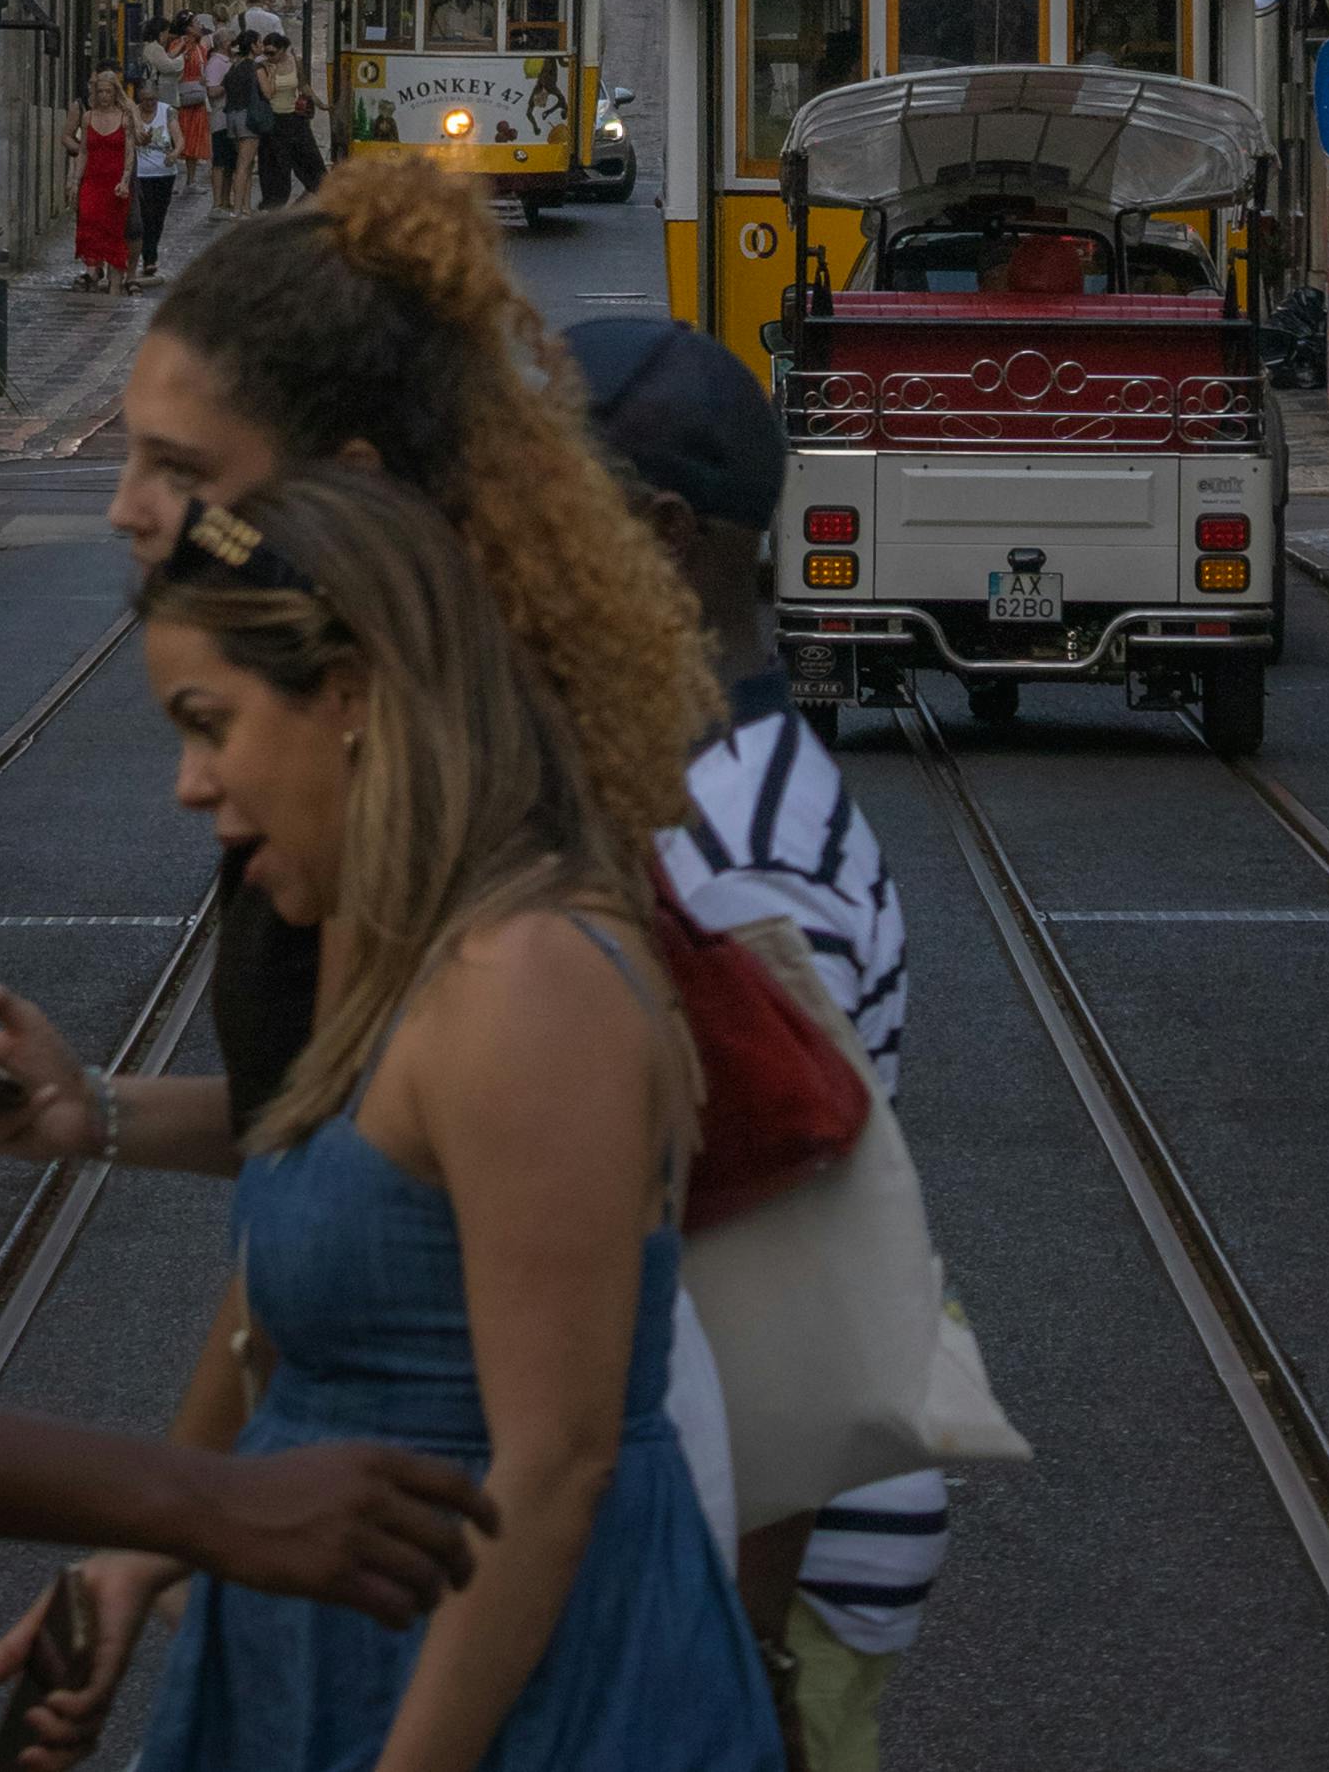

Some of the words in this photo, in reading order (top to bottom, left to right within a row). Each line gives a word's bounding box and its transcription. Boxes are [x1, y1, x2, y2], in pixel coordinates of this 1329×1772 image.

[396, 77, 497, 105] MONKEY
[500, 86, 525, 106] 47
[1009, 575, 1043, 597] AX
